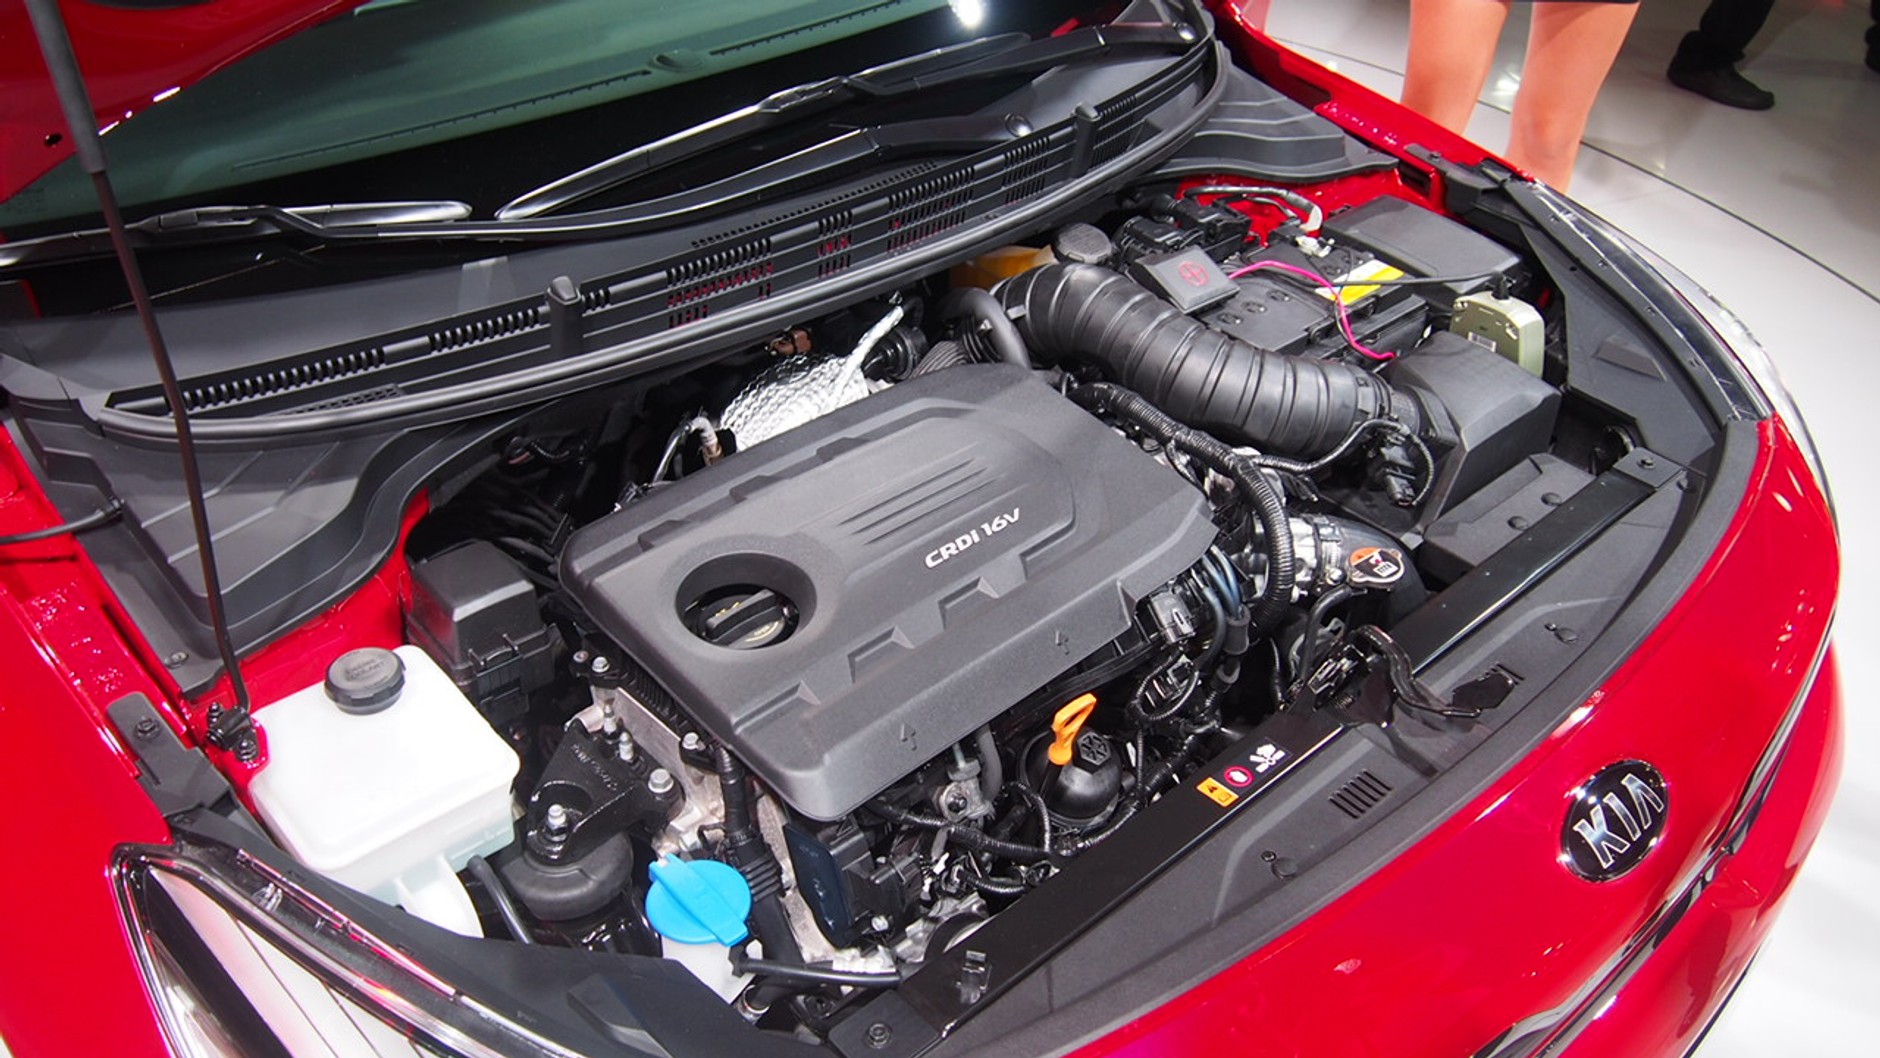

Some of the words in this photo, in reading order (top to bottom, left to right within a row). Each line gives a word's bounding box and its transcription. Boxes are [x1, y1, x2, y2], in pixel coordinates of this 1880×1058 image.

[925, 528, 980, 568] CRDI
[981, 507, 1020, 536] 16V
[1572, 772, 1665, 869] KIA
